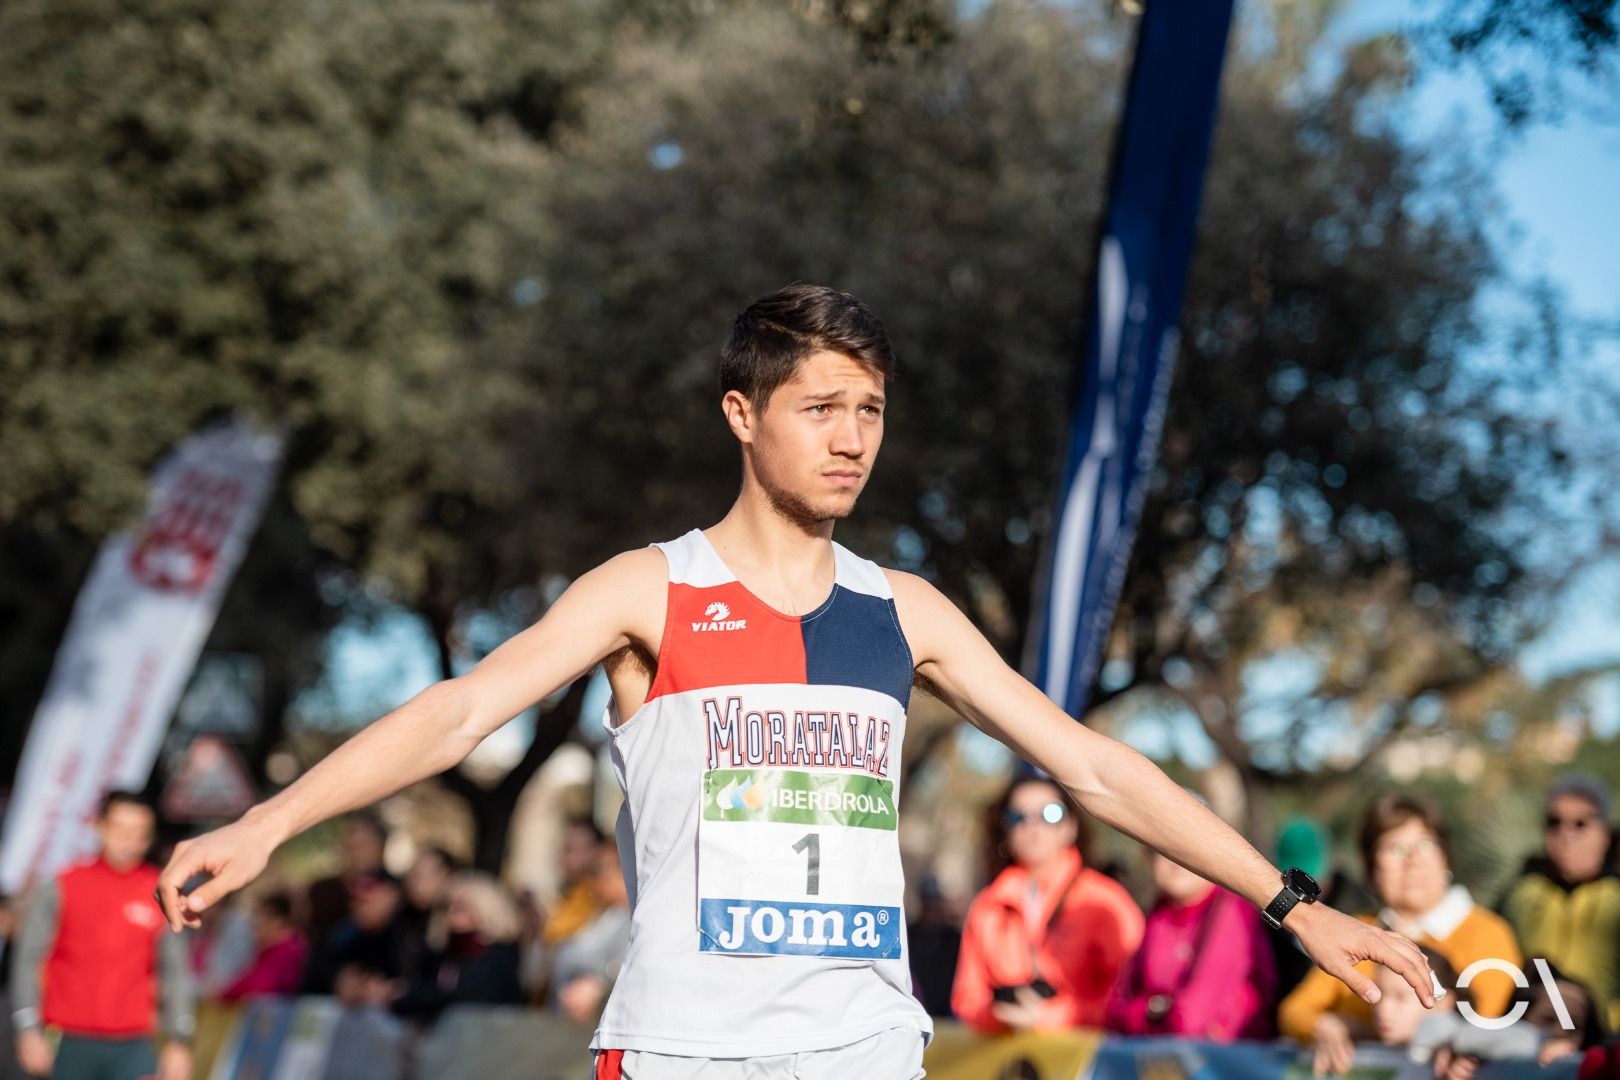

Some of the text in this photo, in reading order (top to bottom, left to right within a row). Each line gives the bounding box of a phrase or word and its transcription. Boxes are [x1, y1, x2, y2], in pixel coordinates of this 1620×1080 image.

[691, 619, 747, 632] VIATOR
[702, 696, 890, 779] MORATALAZ
[770, 789, 890, 815] IBERDROLA
[792, 833, 820, 895] 1
